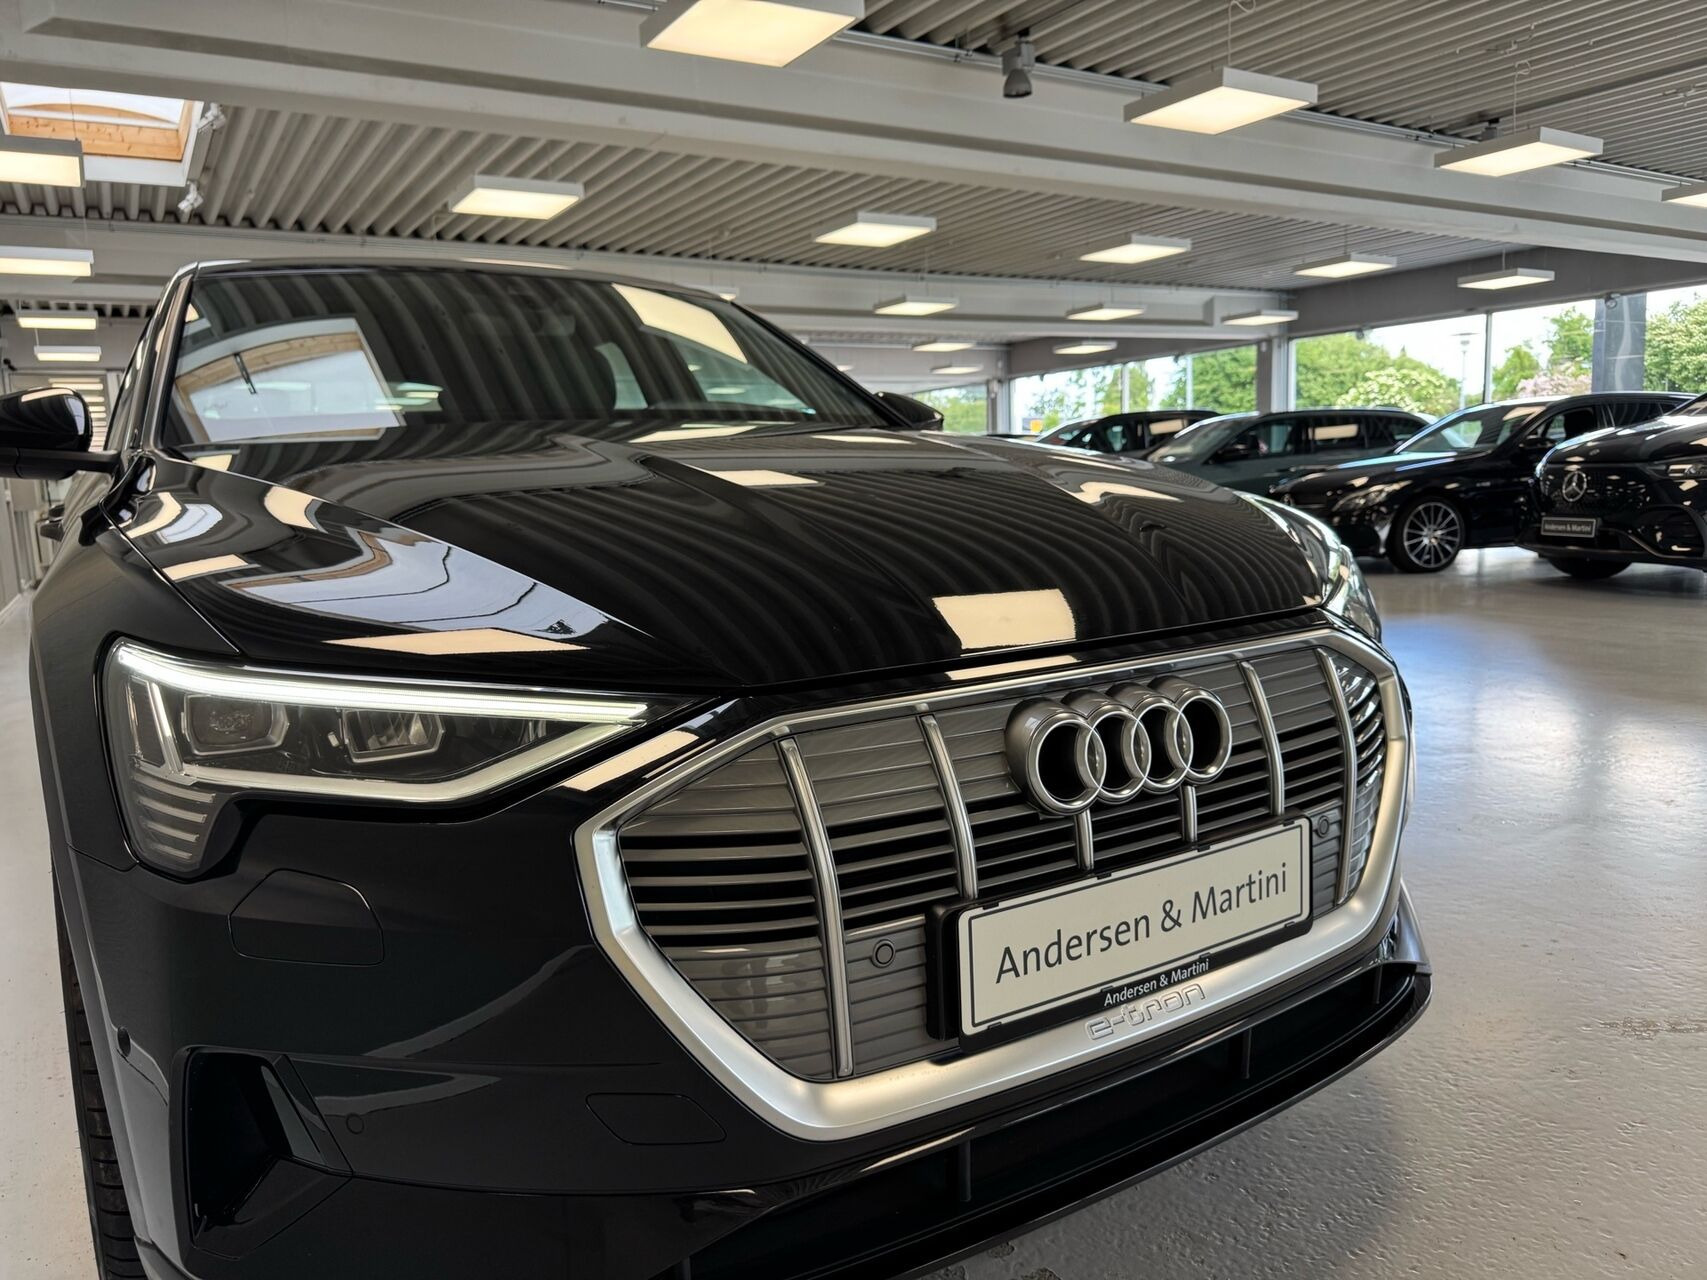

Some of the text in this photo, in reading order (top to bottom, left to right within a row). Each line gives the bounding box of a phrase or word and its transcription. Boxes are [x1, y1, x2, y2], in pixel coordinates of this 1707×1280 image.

[996, 863, 1288, 984] Andersen & Martini
[1103, 958, 1209, 1006] Andersen & Martini
[1085, 983, 1206, 1041] e-tron
